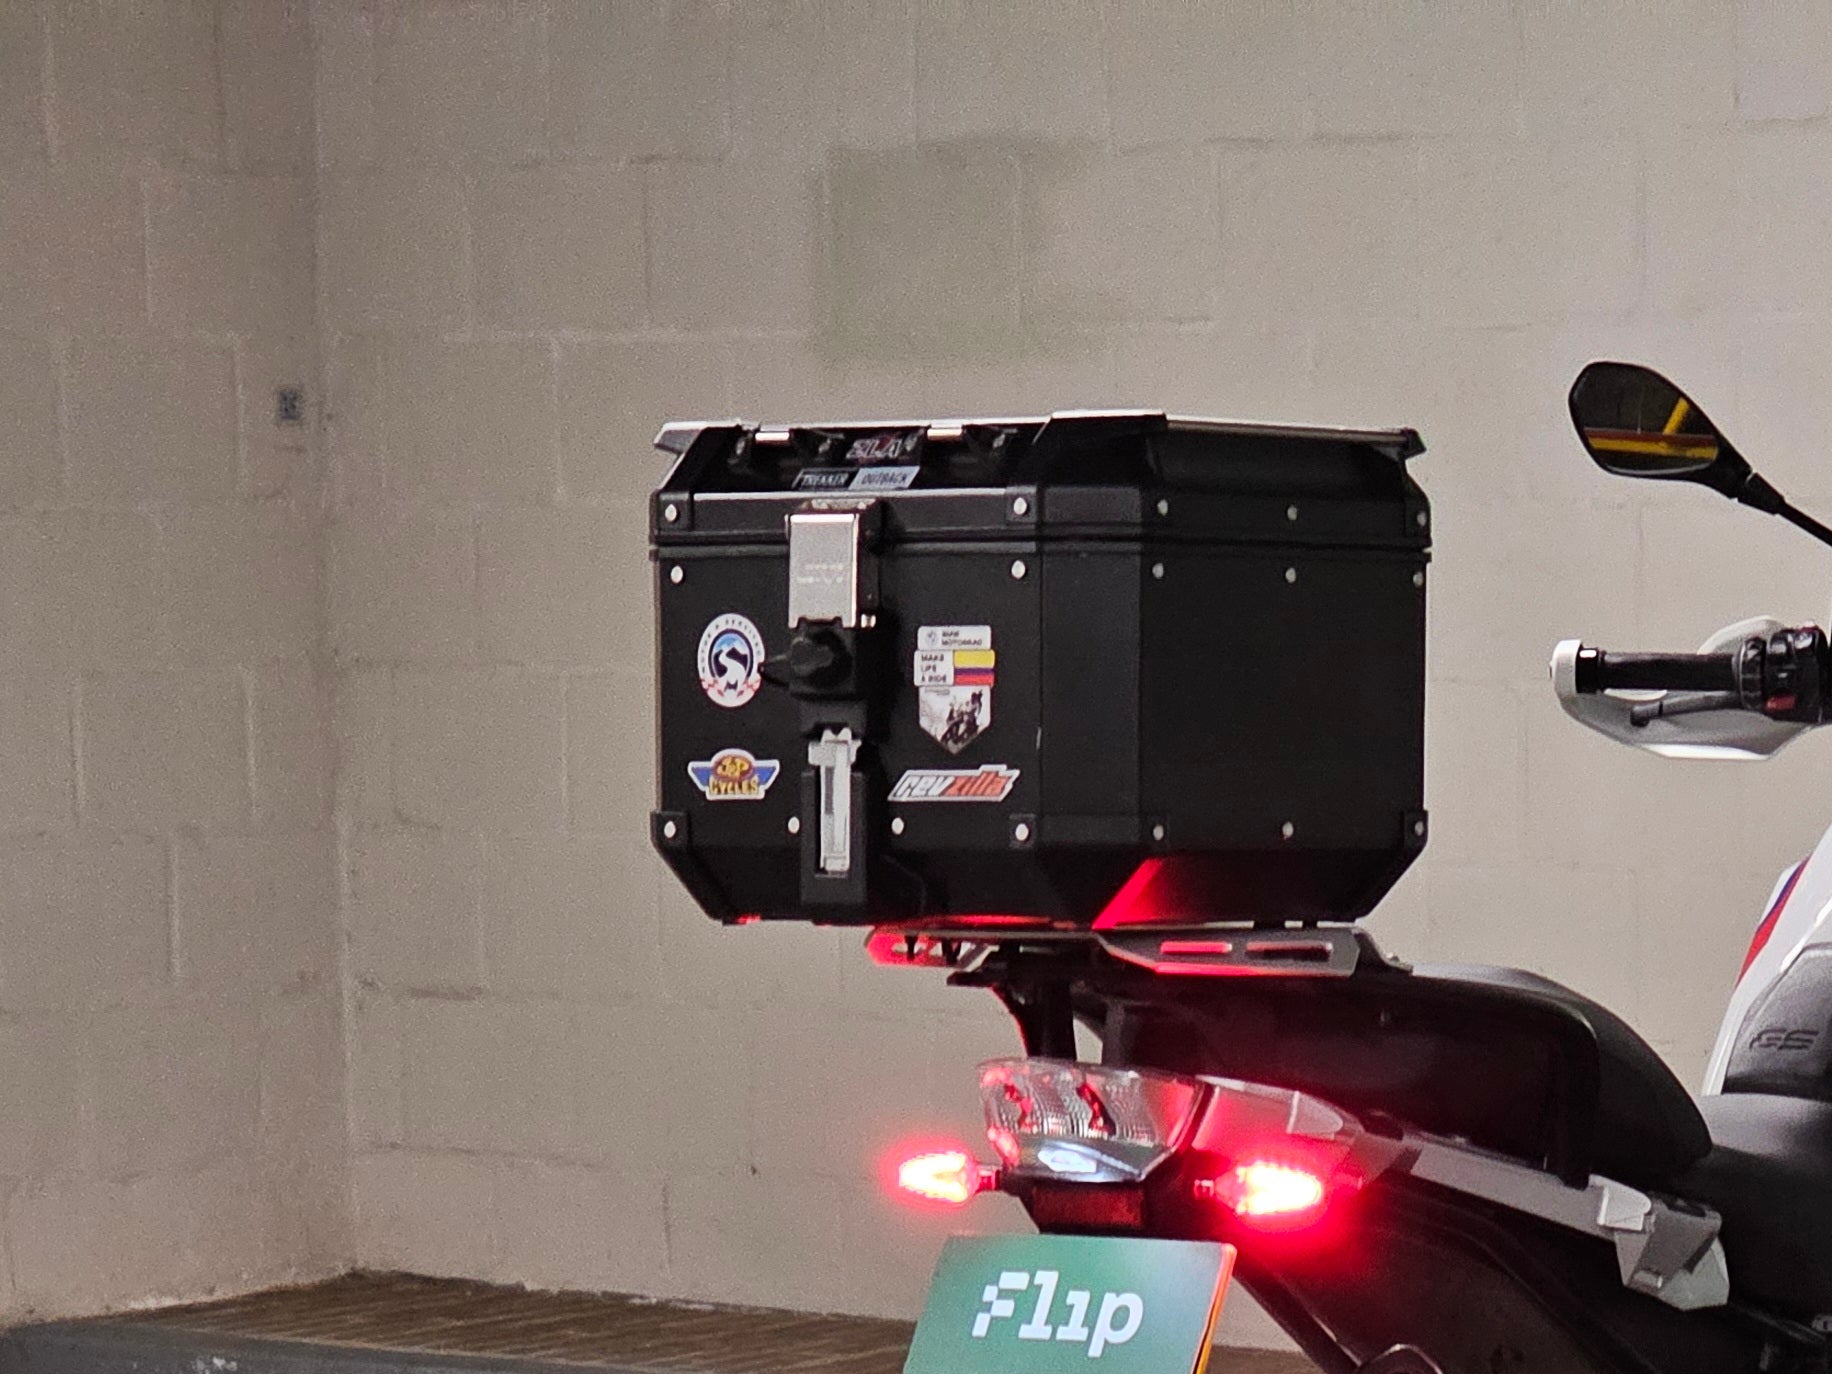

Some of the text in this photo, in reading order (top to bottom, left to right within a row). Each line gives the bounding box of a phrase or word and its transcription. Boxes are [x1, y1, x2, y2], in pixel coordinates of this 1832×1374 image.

[860, 472, 908, 485] OUTBACK
[1748, 1027, 1821, 1053] GS
[972, 1270, 1144, 1358] Flip
